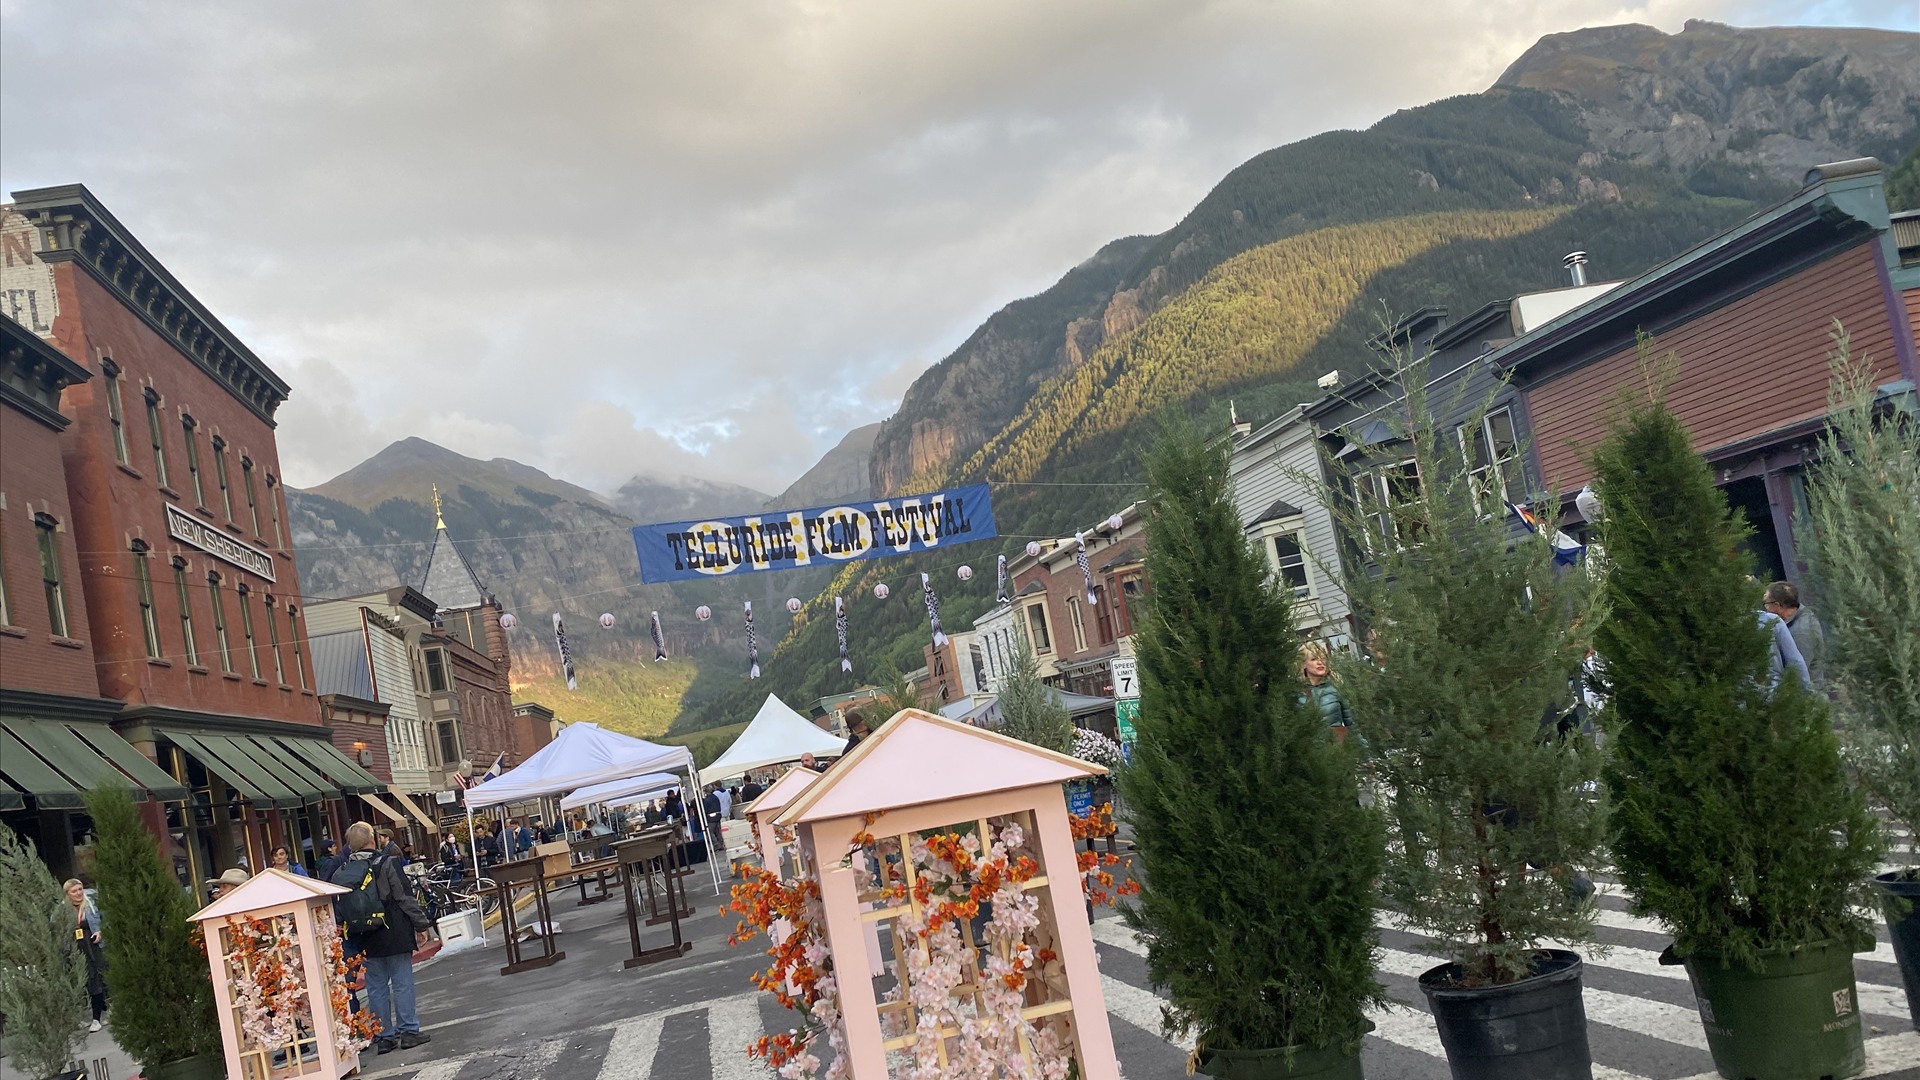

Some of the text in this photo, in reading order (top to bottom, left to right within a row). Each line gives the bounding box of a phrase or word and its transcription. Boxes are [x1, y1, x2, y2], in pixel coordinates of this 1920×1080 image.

[169, 511, 270, 575] NEW SHERIDAN
[667, 498, 972, 570] TELLURIDE FILM FESTIVAL
[1120, 677, 1132, 693] 7
